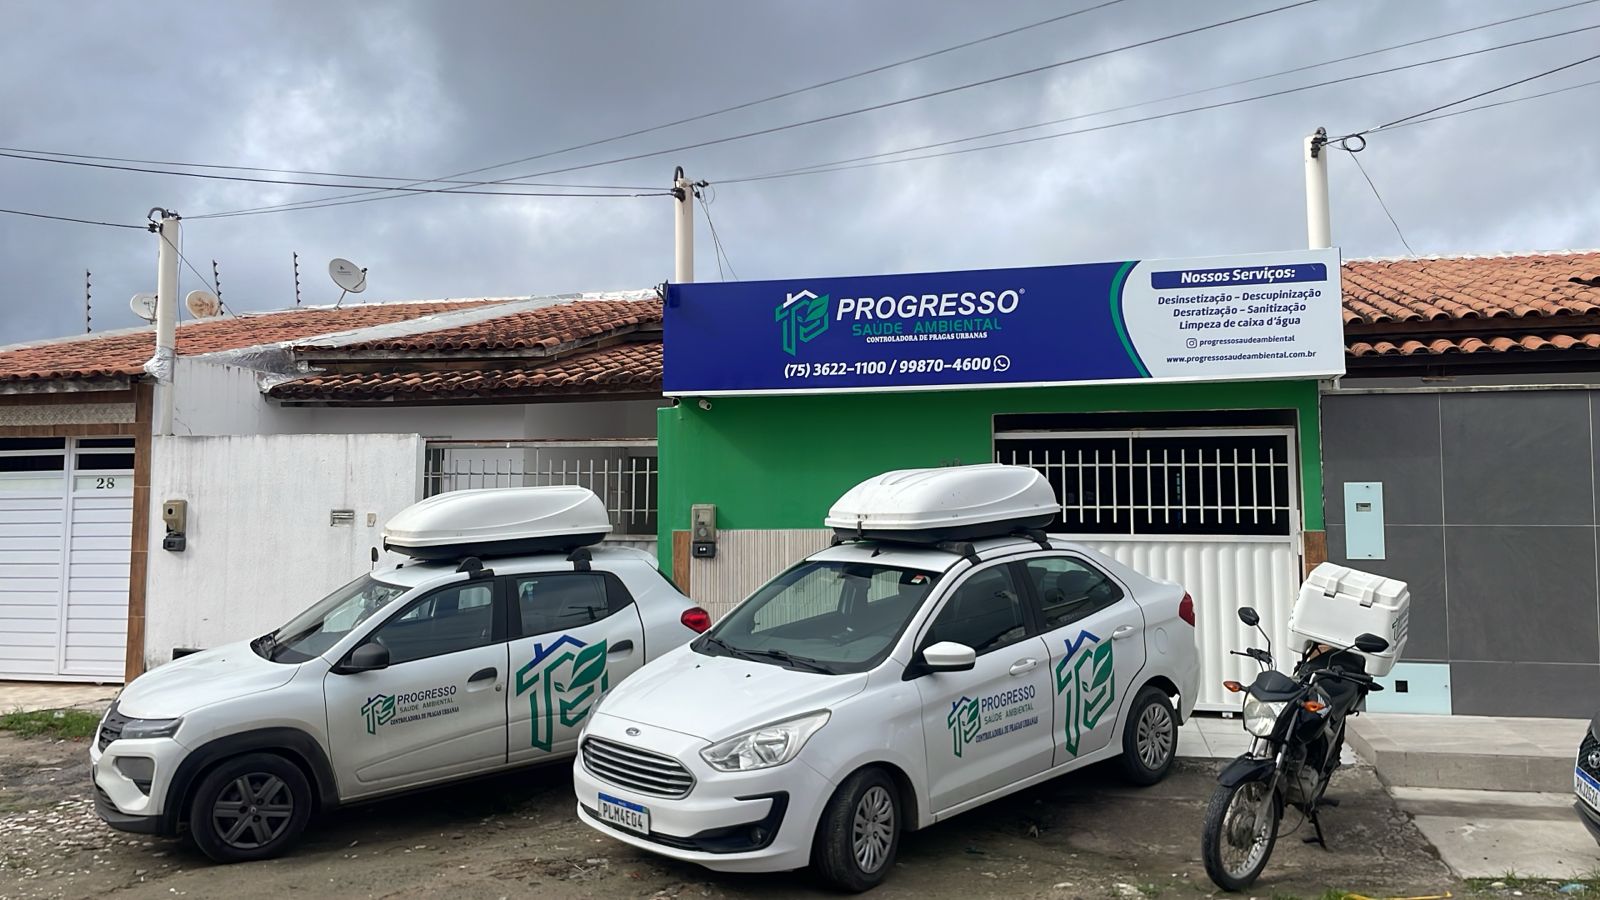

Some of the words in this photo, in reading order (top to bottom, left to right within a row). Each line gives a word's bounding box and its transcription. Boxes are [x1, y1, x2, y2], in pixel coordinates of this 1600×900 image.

[1181, 270, 1230, 284] Nossos
[1232, 266, 1296, 283] Serviços:
[1158, 293, 1232, 305] Desinsetização
[1242, 289, 1322, 303] Descupinização
[1173, 307, 1238, 318] Desratização
[1247, 303, 1307, 315] Sanitização
[852, 318, 903, 337] SAÚDE
[914, 317, 1003, 334] AMBIENTAL
[1179, 320, 1222, 332] Limpeza
[1223, 319, 1236, 328] de
[1237, 318, 1264, 328] caixa
[866, 333, 918, 343] CONTROLADORA
[929, 332, 955, 340] PRAGAS
[956, 331, 988, 340] URBANAS
[1200, 335, 1295, 347] progressosaudeambiental
[1166, 350, 1317, 364] www.progressosaudeambiental.com.br
[784, 362, 811, 379] (75)
[812, 360, 887, 376] 3622–1100
[888, 359, 898, 376] /
[899, 357, 992, 374] 99870–4600
[96, 477, 115, 489] 28
[397, 685, 457, 705] PROGRESSO
[422, 697, 454, 708] AMBIENTAL
[981, 684, 1036, 713] PROGRESSO
[1005, 703, 1034, 718] AMBIENTAL
